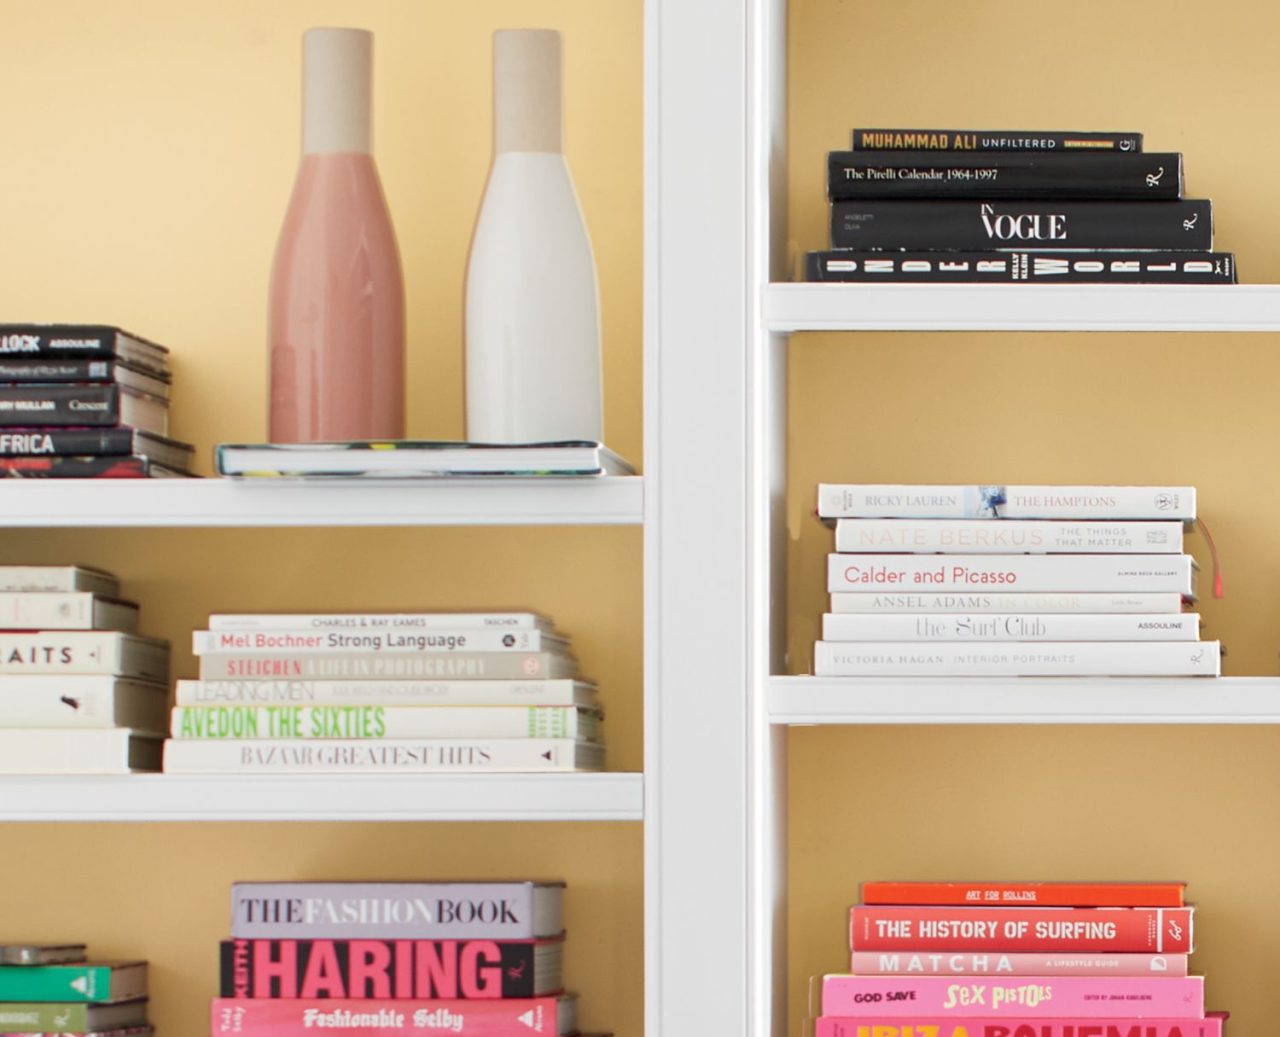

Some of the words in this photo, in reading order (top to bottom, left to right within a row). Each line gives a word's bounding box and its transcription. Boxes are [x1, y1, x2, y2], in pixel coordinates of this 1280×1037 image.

[861, 133, 949, 149] MUHAMMAD
[954, 135, 977, 149] ALI
[981, 138, 1056, 149] UNFILTERED
[980, 203, 994, 215] IN
[981, 214, 1067, 240] VOGUE
[826, 260, 1007, 273] UNDER
[0, 434, 56, 454] FRICA
[864, 494, 903, 507] RICKY
[905, 495, 956, 507] LAUREN
[1014, 496, 1041, 508] THE
[1043, 496, 1116, 508] HAMPTONS
[843, 566, 906, 584] Calder
[912, 566, 946, 584] and
[951, 566, 1017, 584] Picasso
[311, 618, 357, 627] CHARLES
[360, 618, 368, 627] &
[371, 618, 389, 627] RAY
[393, 618, 427, 627] EAMES
[484, 618, 519, 626] TASCHEN
[1138, 622, 1183, 630] ASSOULINE
[220, 634, 250, 648] Mel
[255, 634, 323, 648] Bochner
[328, 633, 382, 650] Strong
[387, 633, 467, 650] Language
[0, 647, 73, 664] AITS
[227, 660, 302, 676] STEICHEN
[181, 706, 259, 738] AVEDON
[266, 706, 304, 737] THE
[310, 706, 386, 738] SIXTIES
[875, 920, 912, 938] THE
[919, 920, 998, 938] HISTORY
[1004, 921, 1028, 938] OF
[1035, 921, 1117, 939] SURFING
[233, 940, 249, 998] KEITH
[253, 939, 503, 999] HARING
[879, 955, 1014, 972] MATCHA
